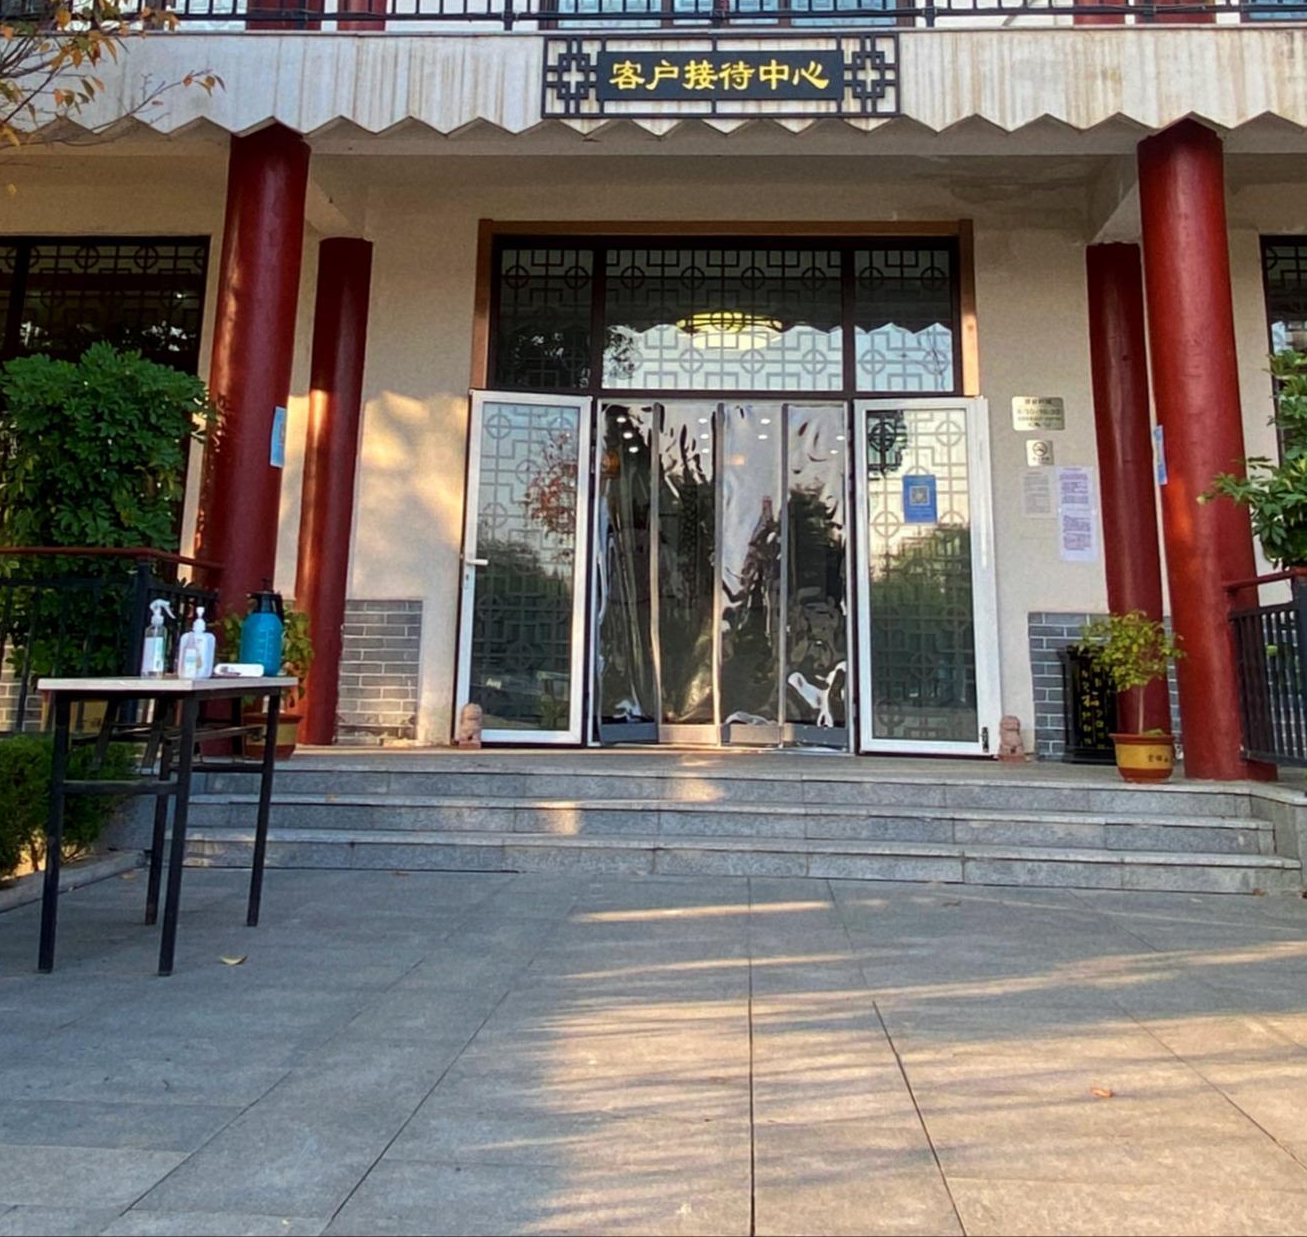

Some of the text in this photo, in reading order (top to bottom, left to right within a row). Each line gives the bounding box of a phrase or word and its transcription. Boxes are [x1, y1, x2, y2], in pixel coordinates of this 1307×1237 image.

[609, 59, 830, 90] 客户接待中心
